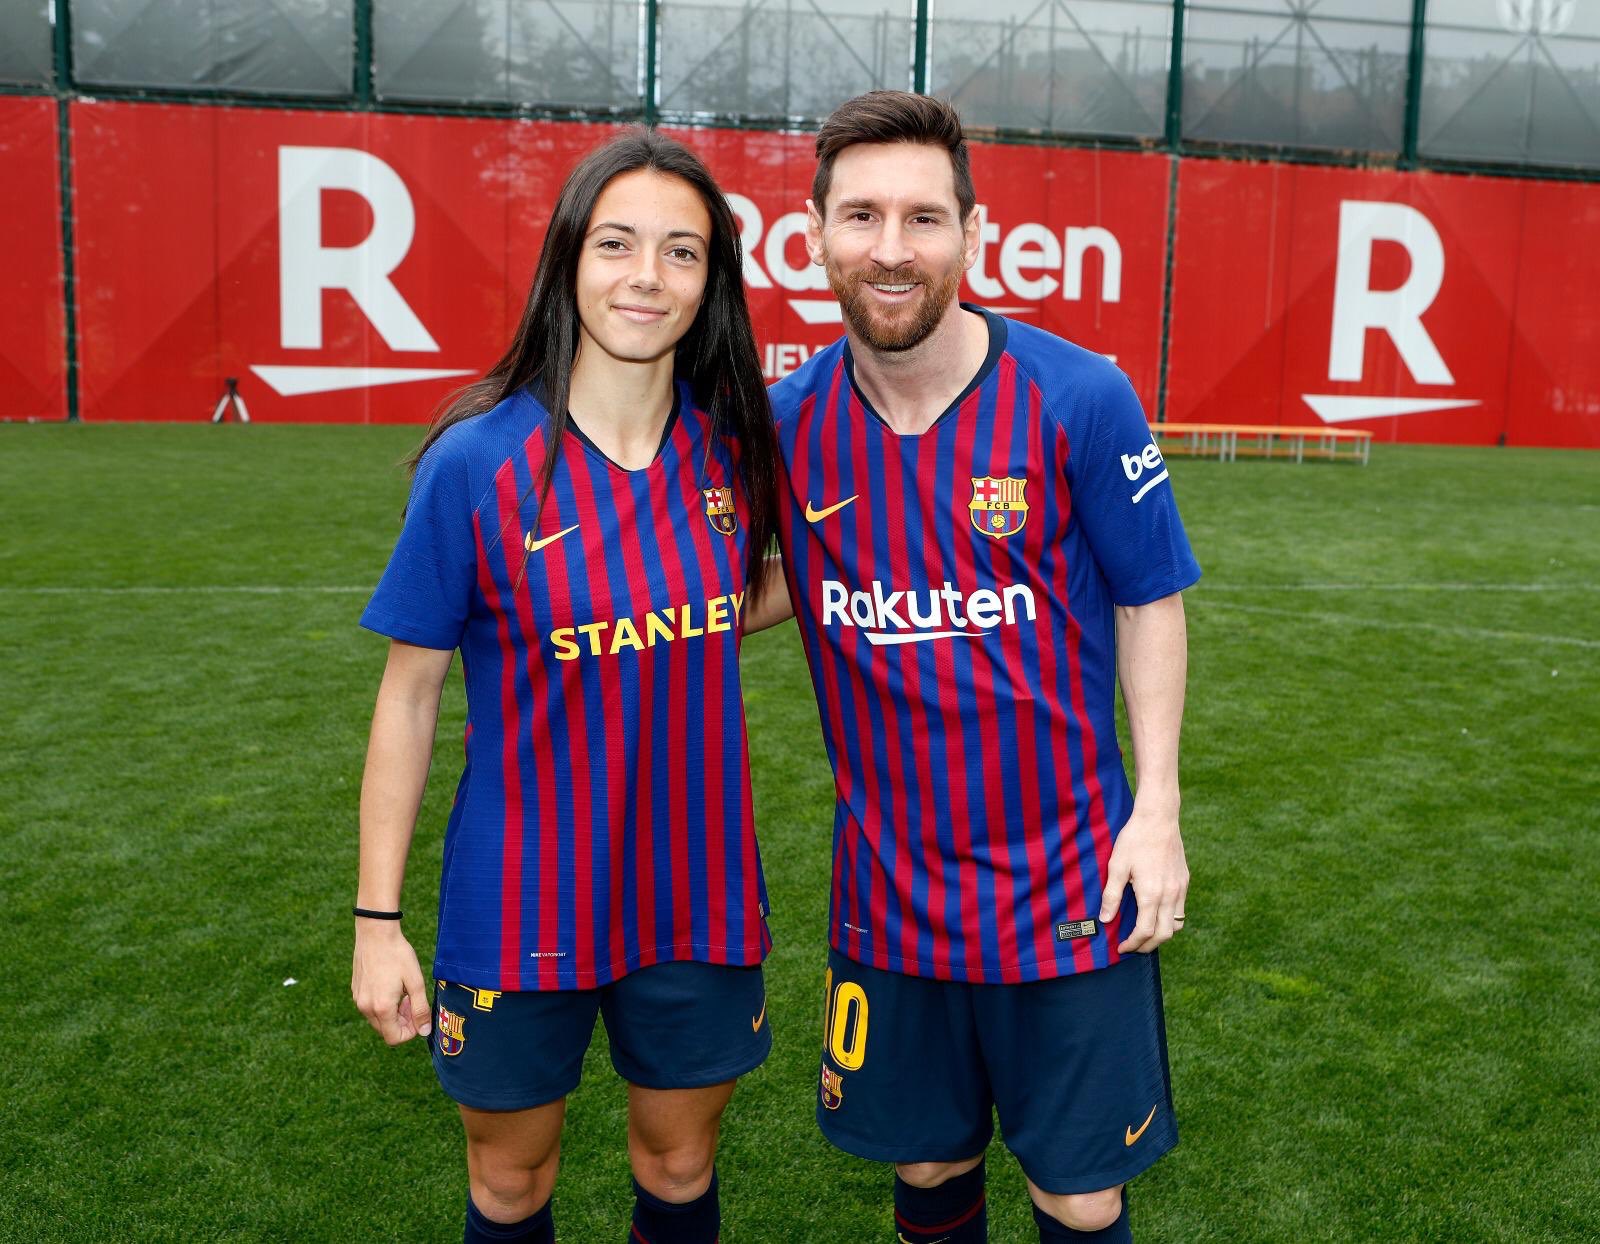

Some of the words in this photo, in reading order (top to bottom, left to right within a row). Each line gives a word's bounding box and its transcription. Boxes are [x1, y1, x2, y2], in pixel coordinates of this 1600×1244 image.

[278, 145, 441, 352] R
[722, 192, 1122, 303] Raten
[1327, 199, 1456, 386] R
[550, 590, 745, 661] STANLEY
[822, 580, 1037, 629] Rakuten
